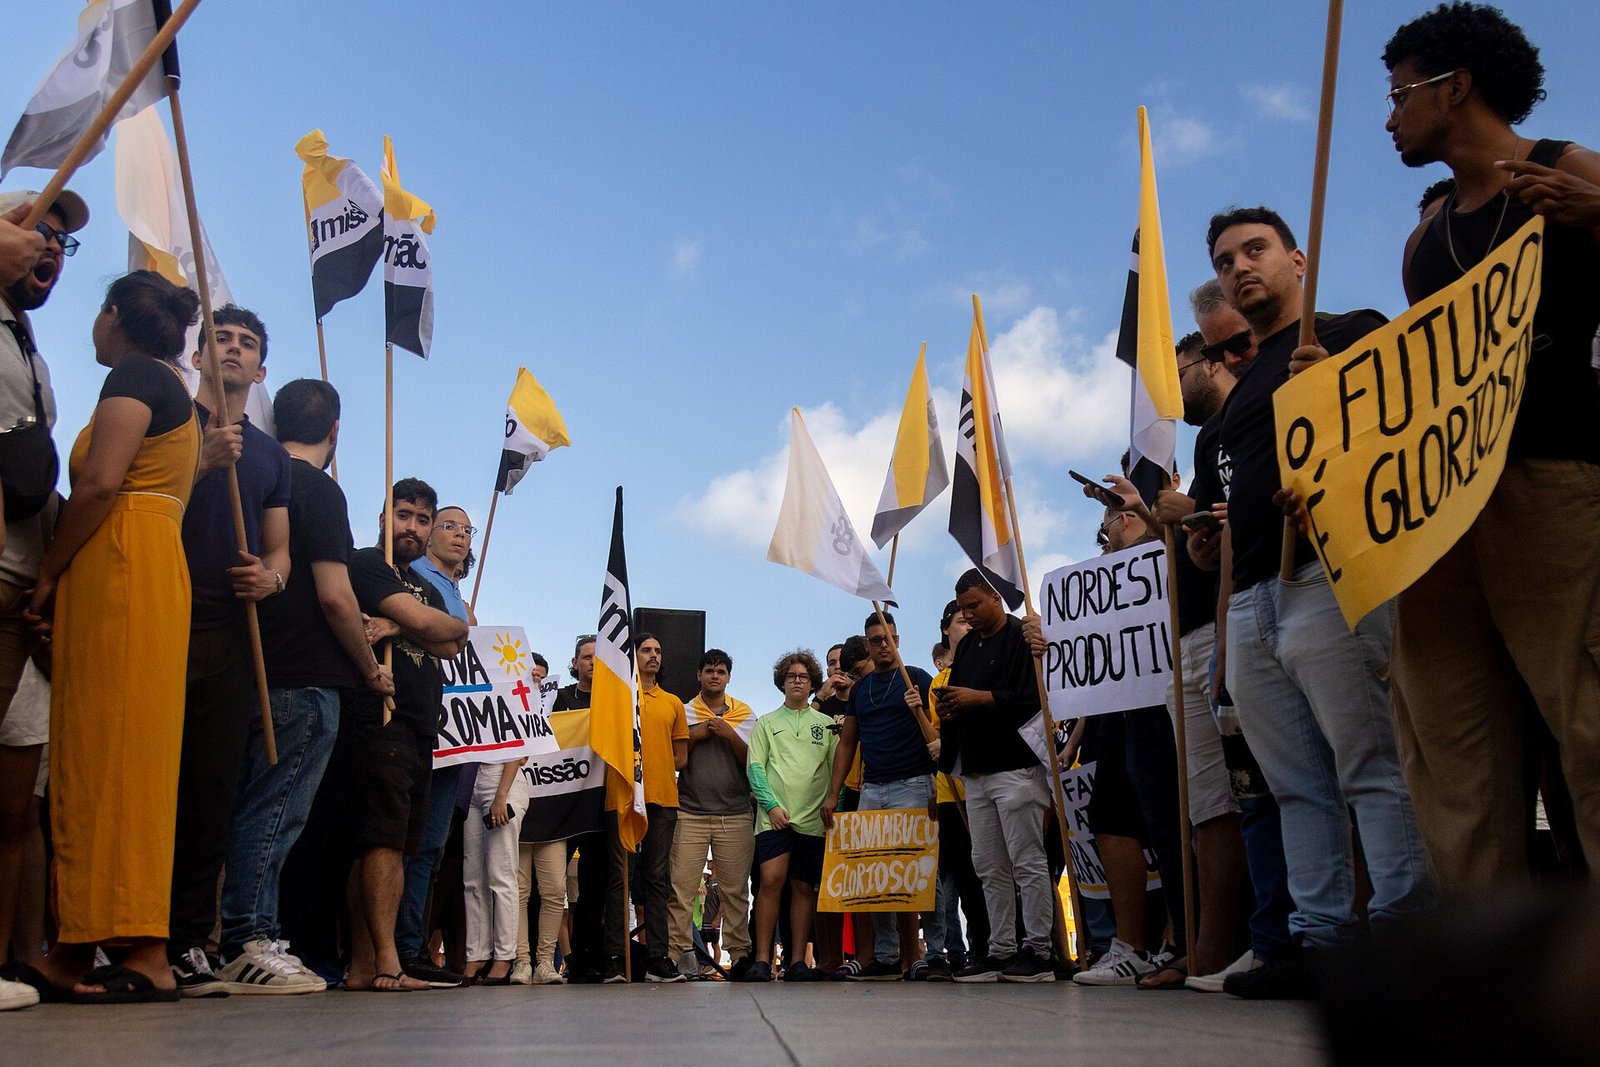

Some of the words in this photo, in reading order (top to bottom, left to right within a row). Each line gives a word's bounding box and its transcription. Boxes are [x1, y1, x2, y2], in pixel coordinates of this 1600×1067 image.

[1286, 416, 1315, 470] O
[1339, 231, 1542, 452] FUTURO
[1306, 459, 1342, 583] É
[1364, 321, 1532, 545] GLORIOSO
[1048, 549, 1168, 626] NORDEST
[441, 640, 491, 687] OVA
[827, 813, 940, 853] PERNAMBUCO
